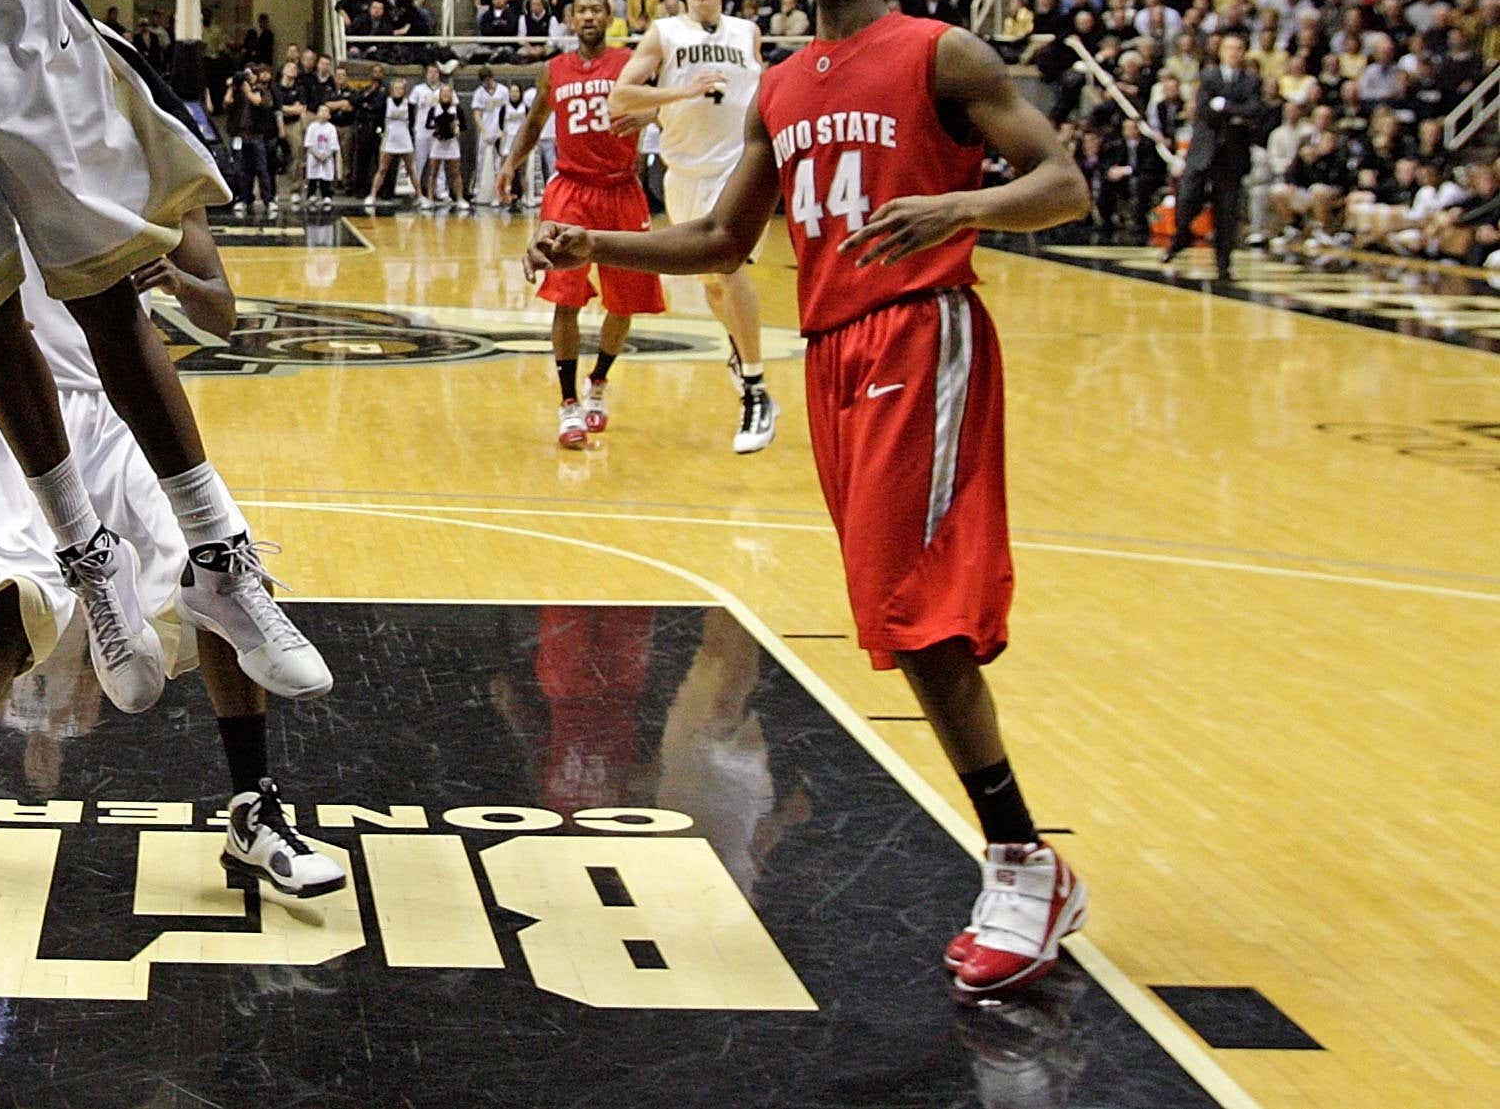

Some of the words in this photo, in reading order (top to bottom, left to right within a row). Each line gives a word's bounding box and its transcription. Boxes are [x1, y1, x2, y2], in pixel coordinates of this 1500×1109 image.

[676, 44, 747, 69] PURDUE
[556, 82, 583, 103] OHIO
[568, 95, 612, 135] 23
[816, 111, 897, 148] STATE
[792, 149, 870, 239] 44
[130, 830, 819, 1011] BIG
